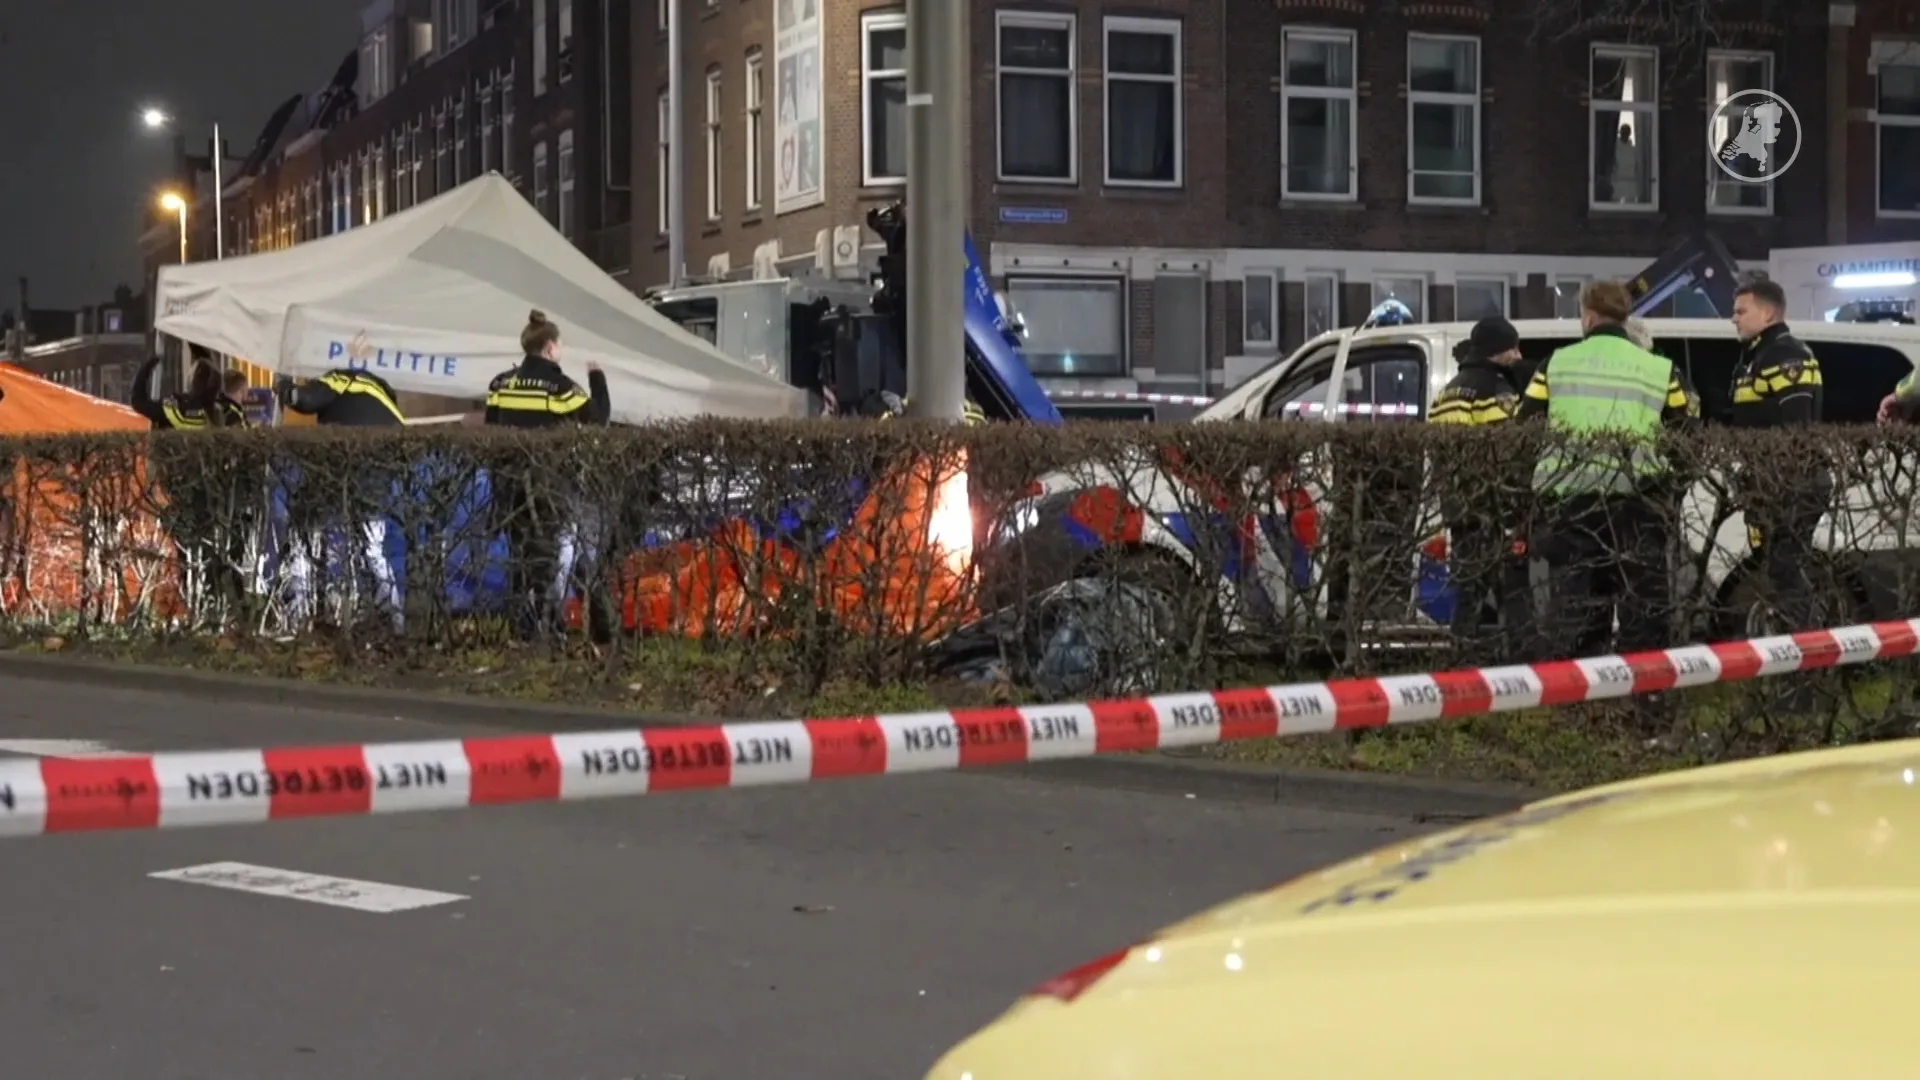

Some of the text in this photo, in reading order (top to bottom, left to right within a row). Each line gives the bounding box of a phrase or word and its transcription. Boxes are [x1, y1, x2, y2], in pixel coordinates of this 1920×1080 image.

[328, 339, 458, 376] POLITIE
[1280, 695, 1322, 718] NIET
[903, 717, 1023, 753] BETREDEN
[1032, 714, 1080, 742] NIET
[582, 740, 728, 776] BETREDEN
[735, 736, 793, 765] NIET
[186, 765, 366, 800] BETREDEN
[376, 761, 447, 789] NIET
